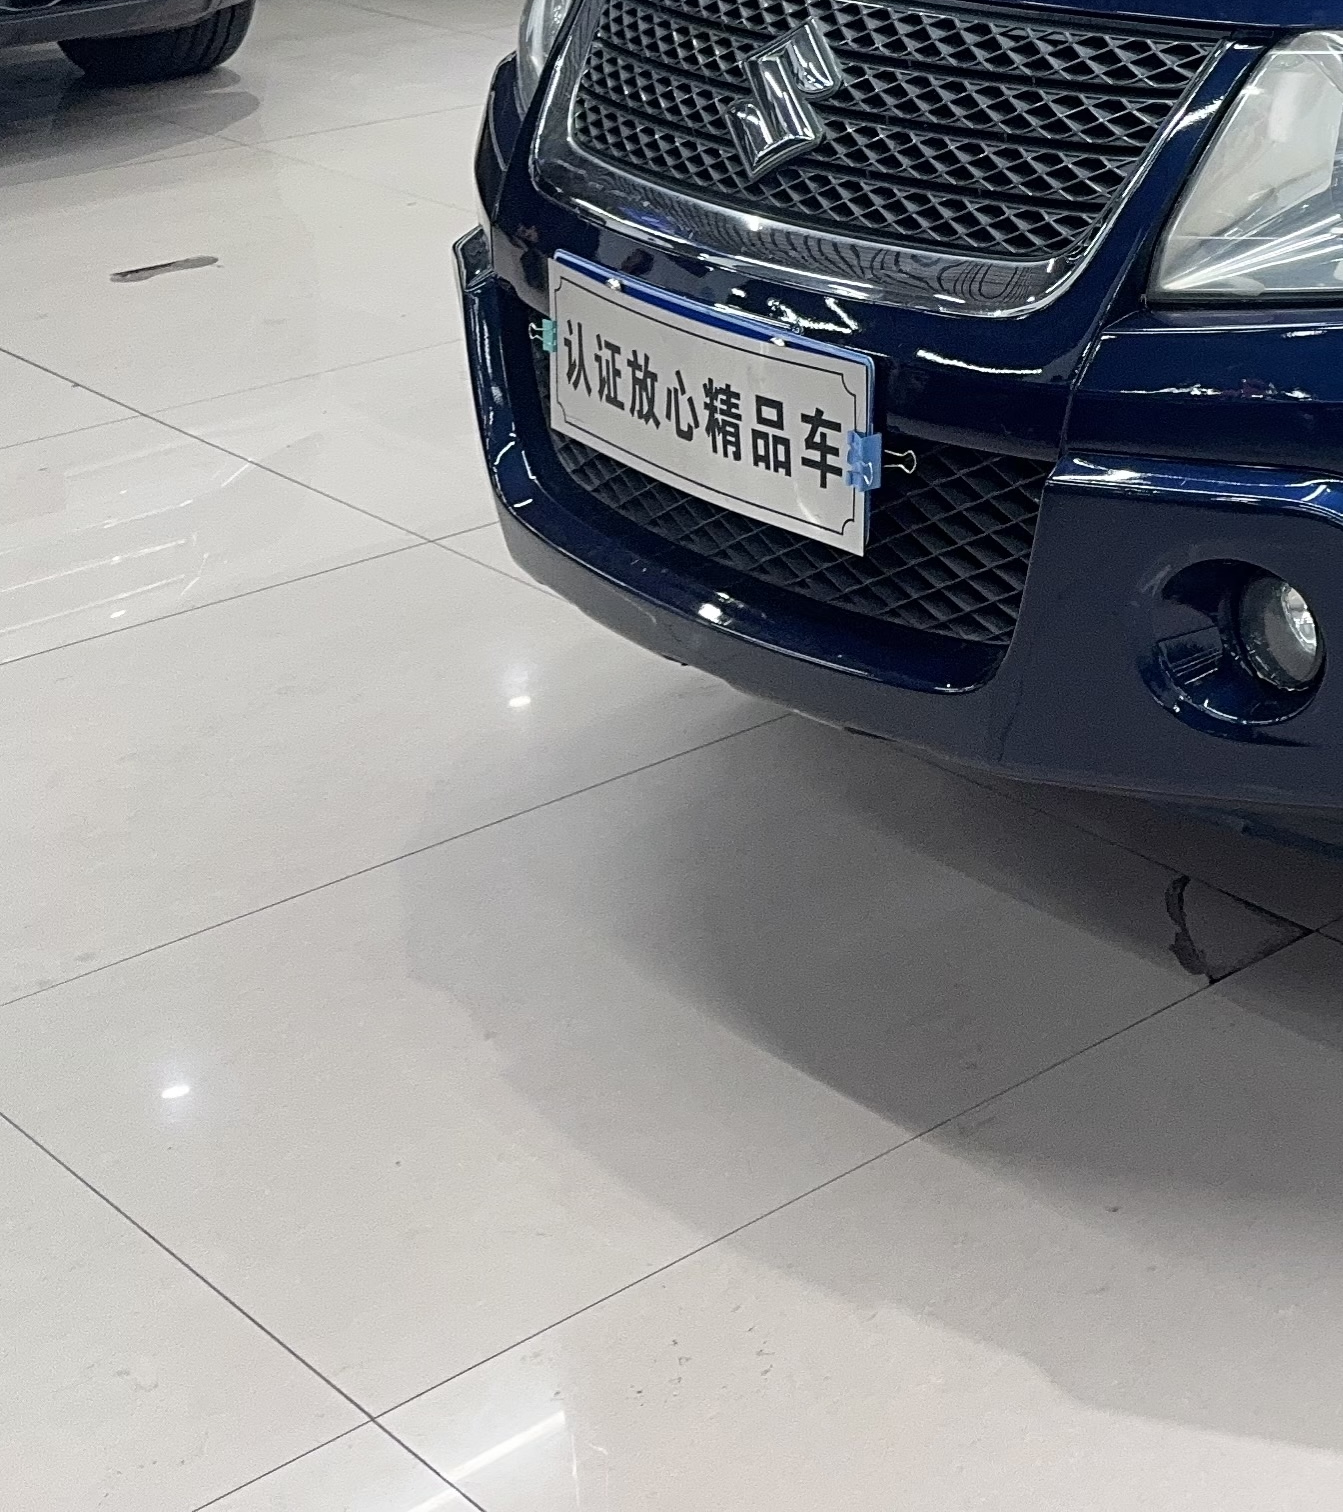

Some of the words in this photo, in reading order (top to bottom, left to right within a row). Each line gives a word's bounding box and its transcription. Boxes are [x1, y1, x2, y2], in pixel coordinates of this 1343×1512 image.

[563, 319, 843, 489] 认证放心精品车
